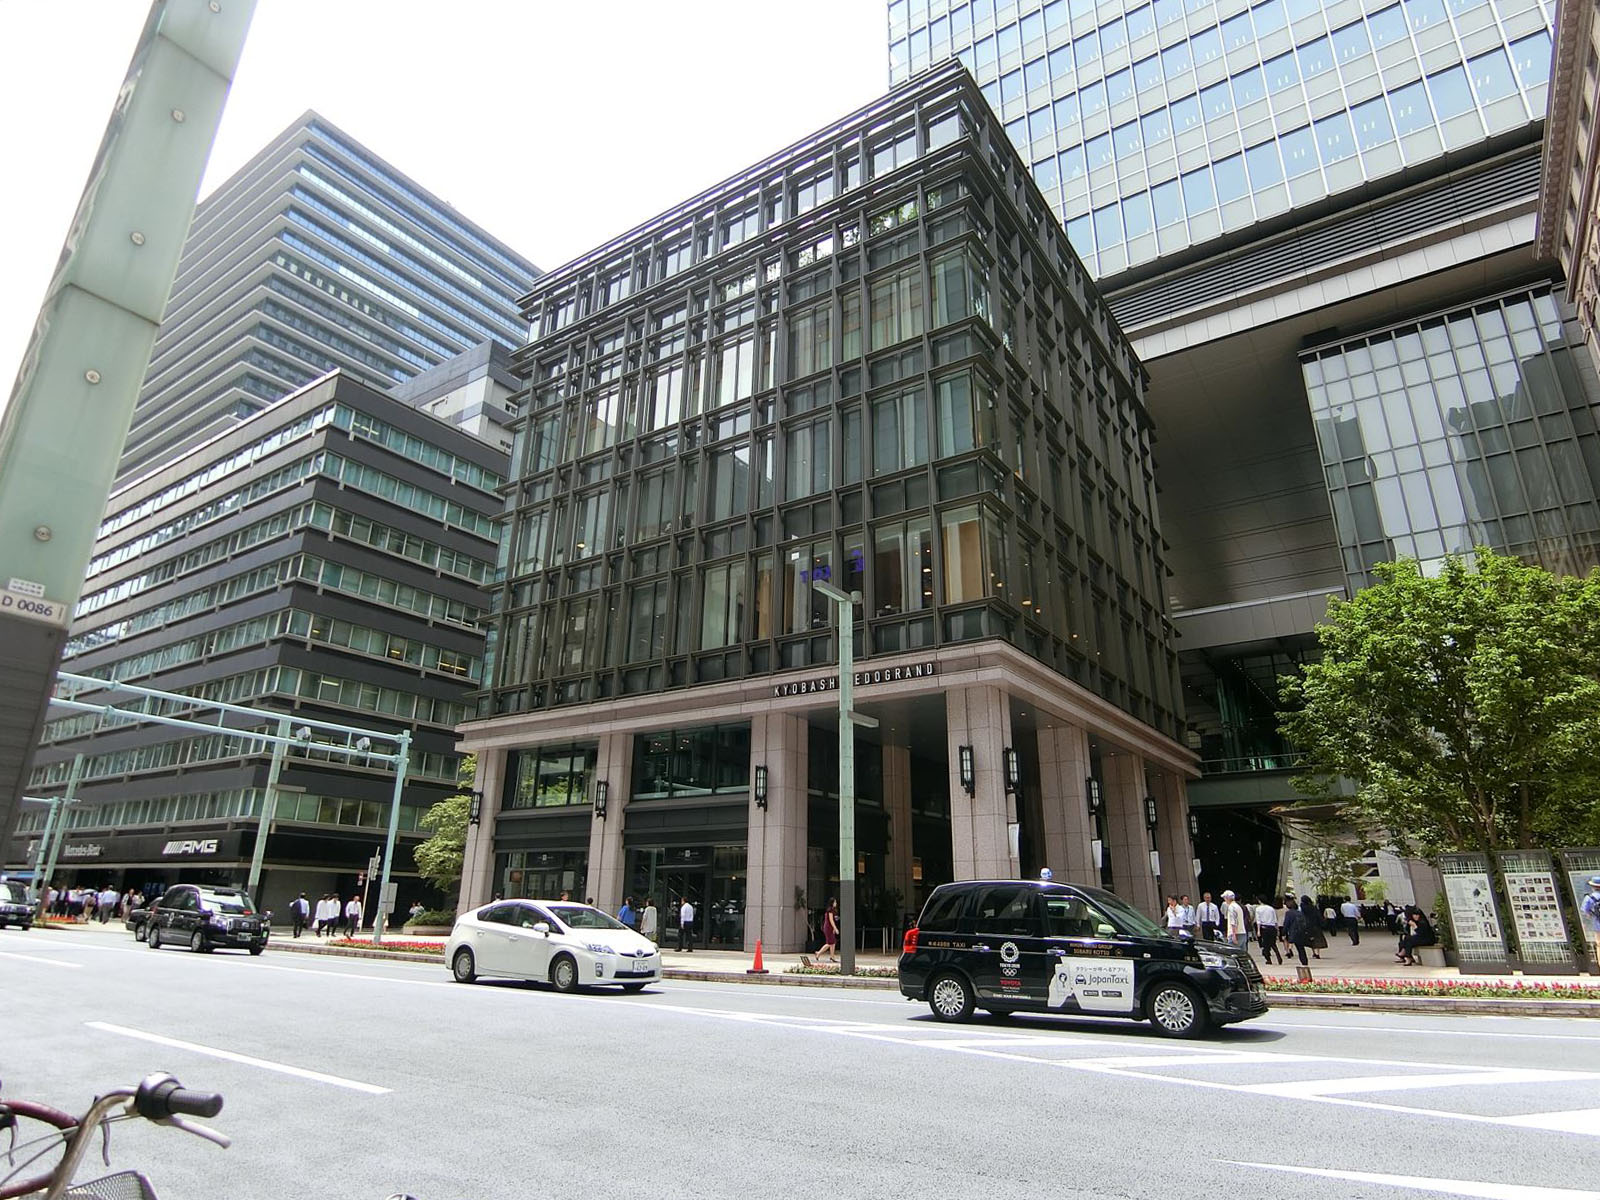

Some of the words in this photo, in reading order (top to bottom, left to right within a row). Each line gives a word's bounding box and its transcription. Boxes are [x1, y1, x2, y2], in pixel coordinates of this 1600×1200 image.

[2, 595, 13, 606] D
[17, 599, 53, 616] 0086
[774, 678, 835, 697] KYOBASH
[855, 663, 934, 685] EDOGRAND
[181, 840, 218, 854] AMG
[1088, 974, 1129, 985] JapanTaxi
